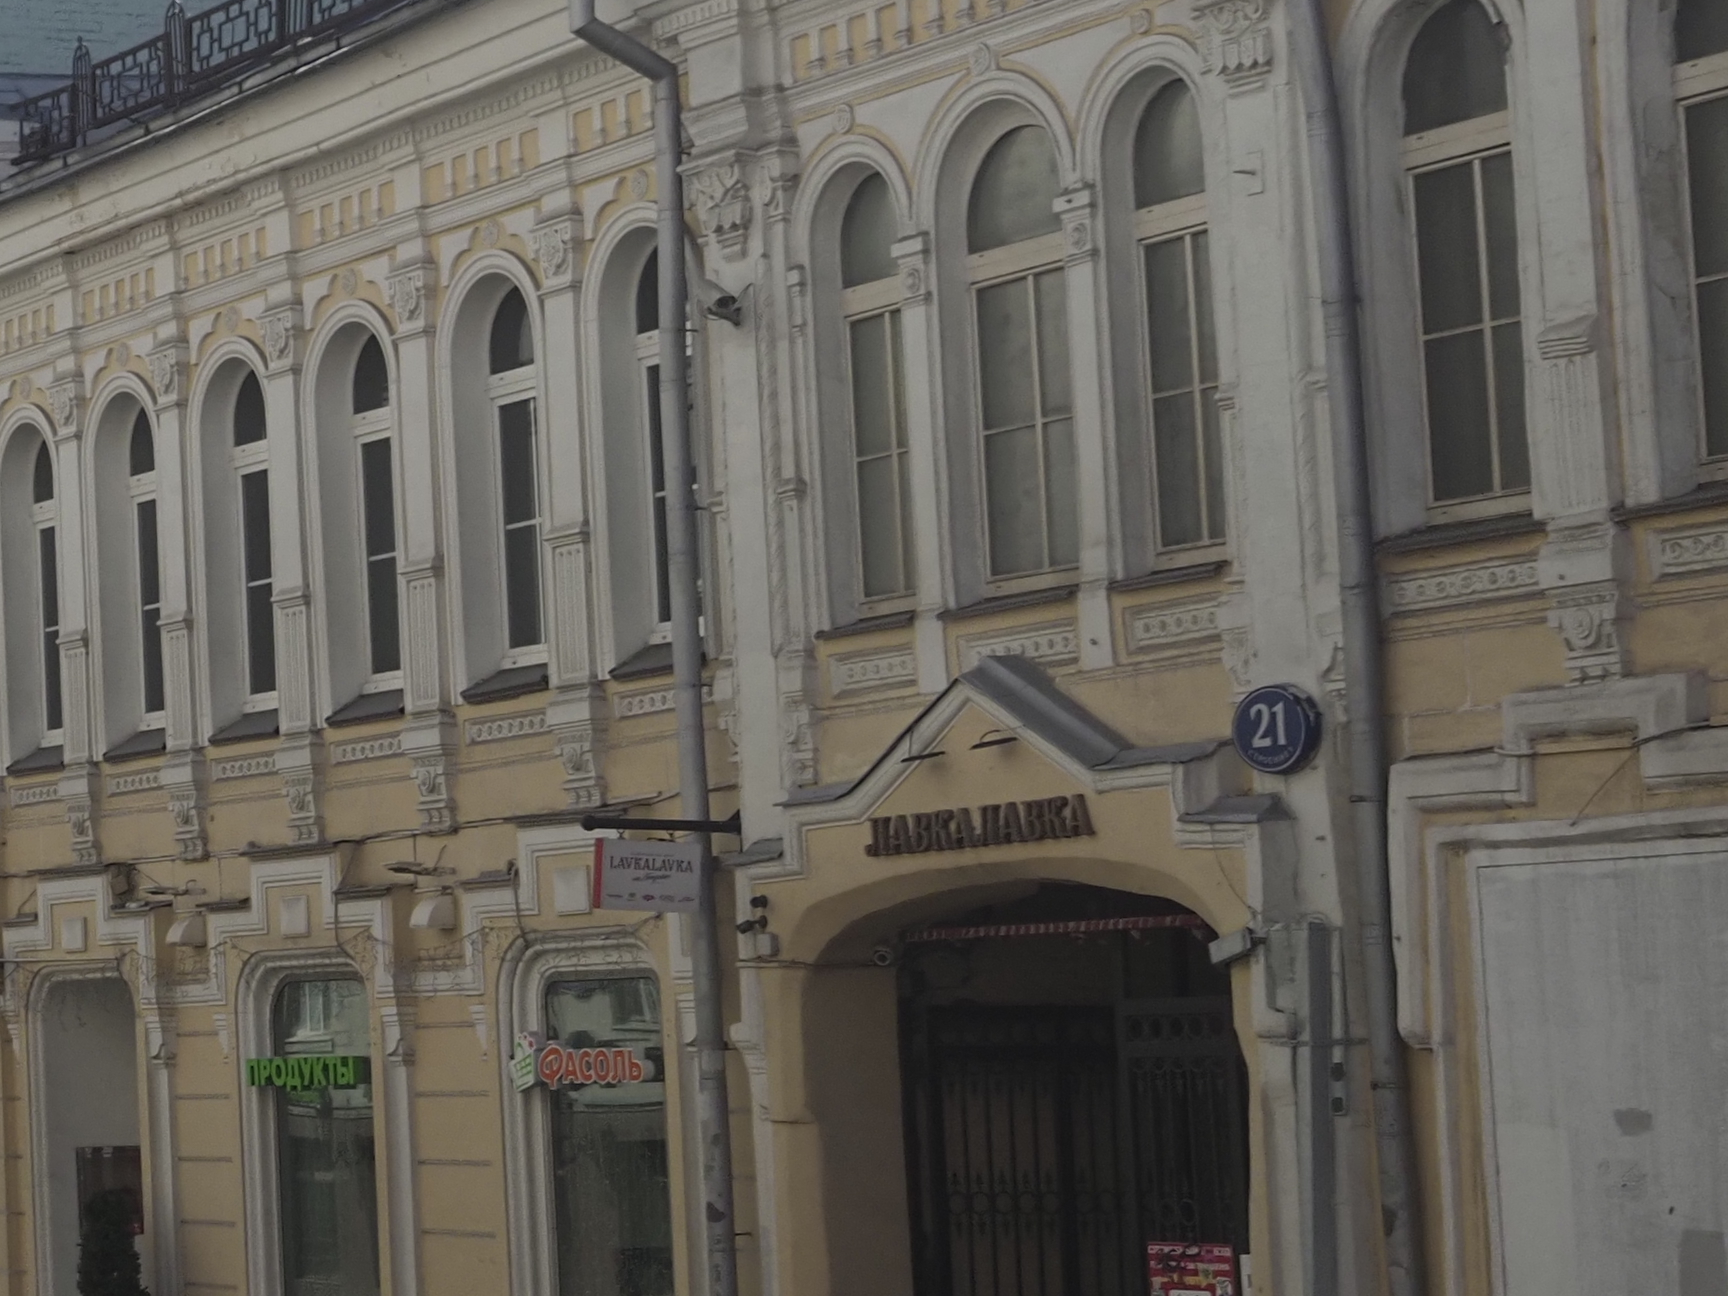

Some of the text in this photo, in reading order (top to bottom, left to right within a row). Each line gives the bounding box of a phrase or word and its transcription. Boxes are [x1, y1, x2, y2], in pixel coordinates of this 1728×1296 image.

[1249, 701, 1288, 748] 21
[609, 855, 693, 873] LAVKALAVKA
[247, 1056, 355, 1092] ПРОДУКТЫ
[539, 1045, 643, 1090] ФАСОЛЬ
